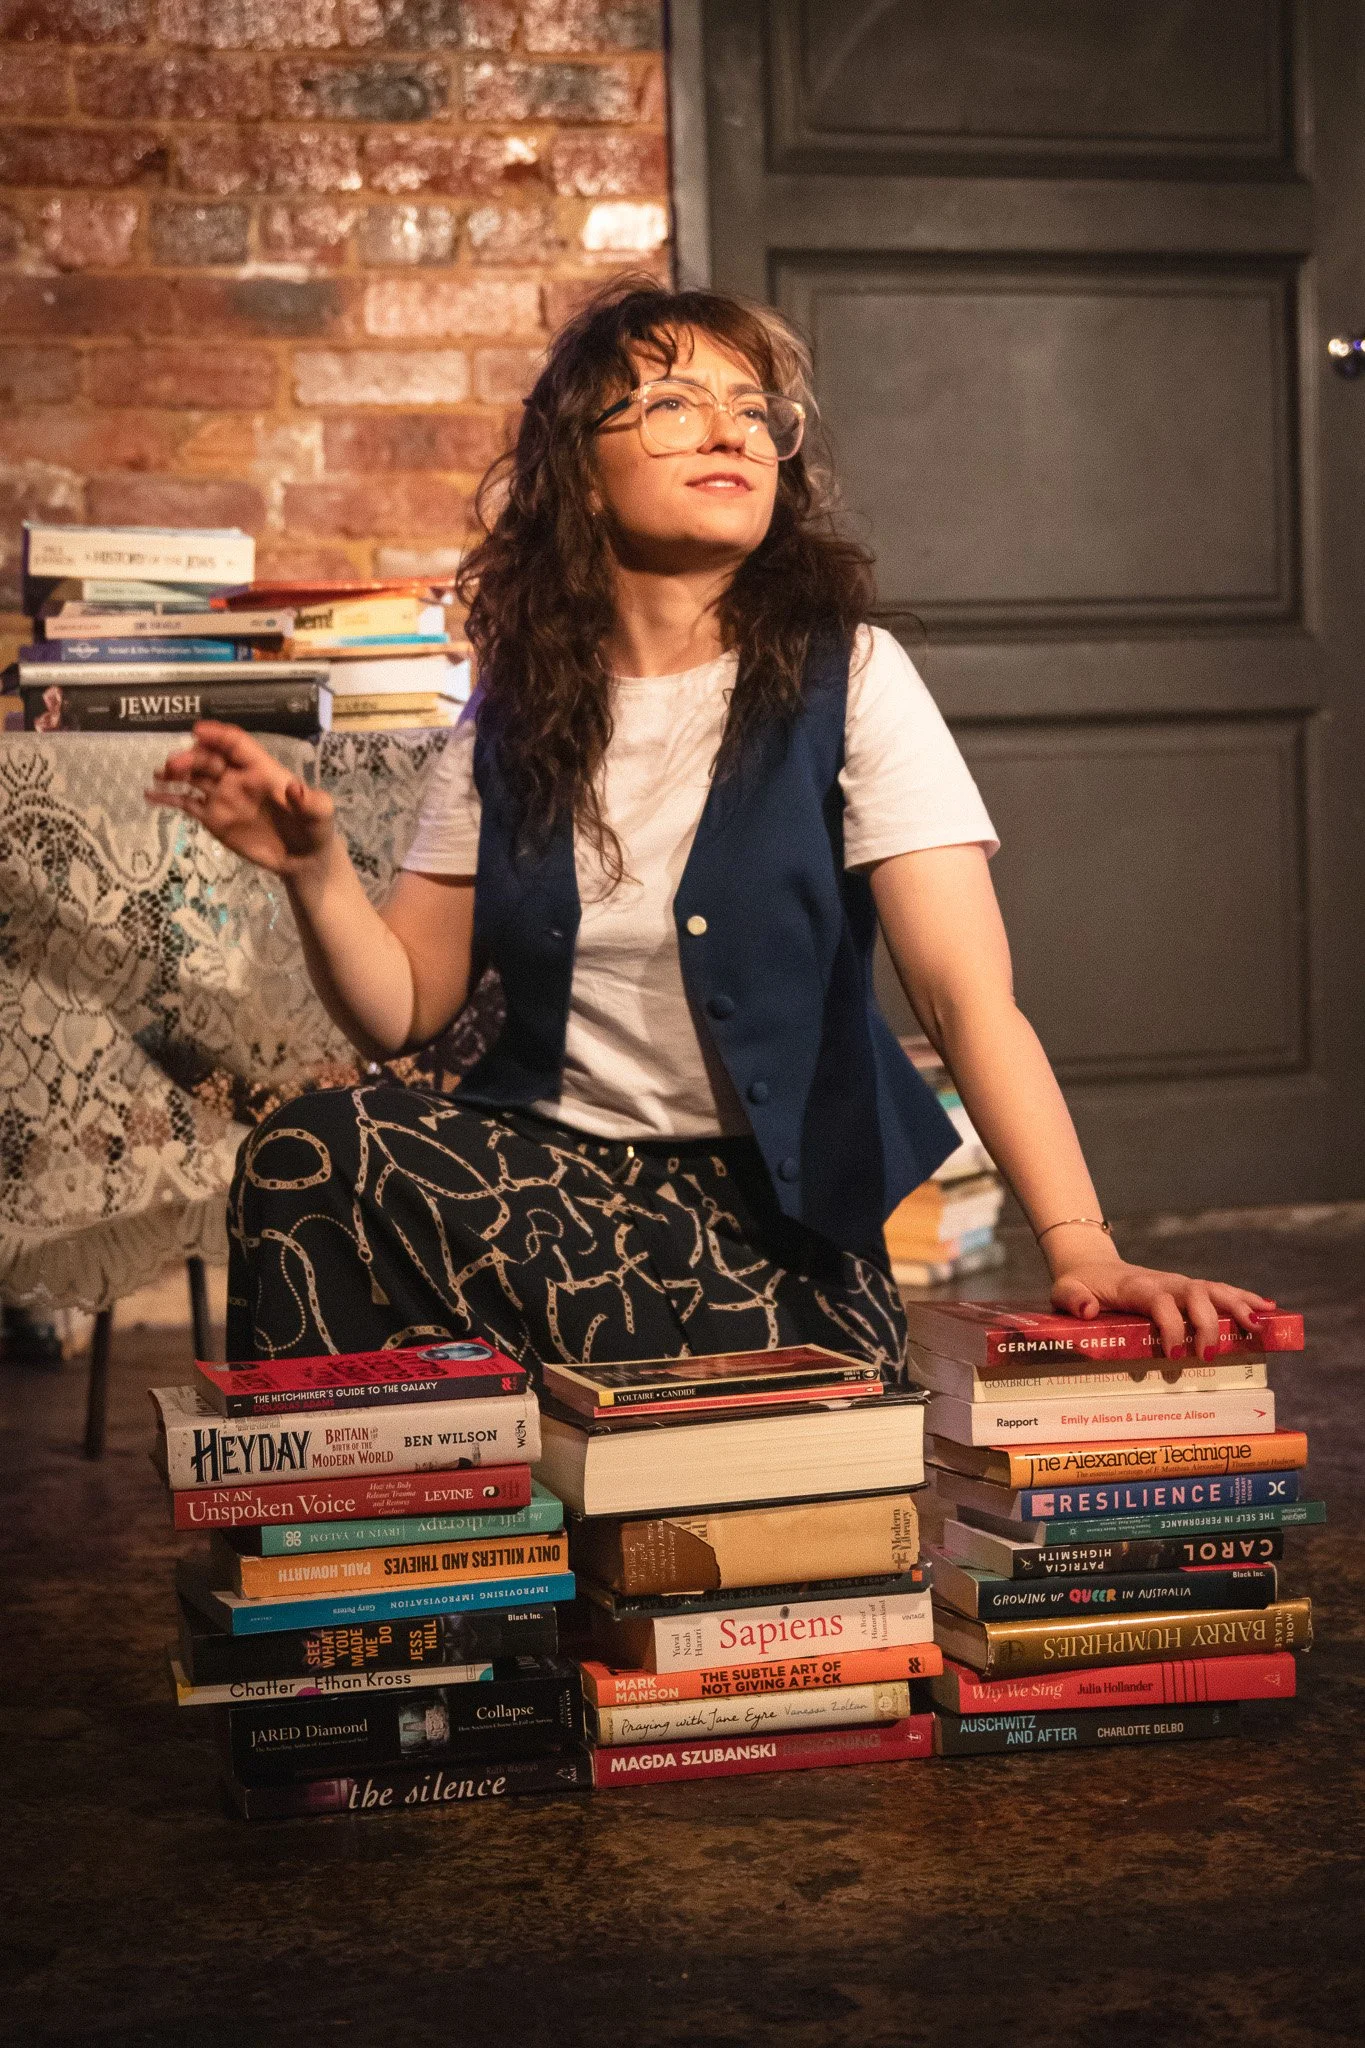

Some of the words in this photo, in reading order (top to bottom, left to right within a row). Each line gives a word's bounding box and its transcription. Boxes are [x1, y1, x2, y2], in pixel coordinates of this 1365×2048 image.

[119, 695, 200, 718] JEWISH
[997, 1339, 1074, 1353] GERMAINE
[1080, 1336, 1126, 1349] GREER
[985, 1377, 1041, 1389] GOMBRICH
[1056, 1375, 1091, 1384] LITTLE
[1180, 1368, 1216, 1379] WORLD
[254, 1395, 269, 1403] THE
[272, 1390, 334, 1402] HITCHHIKER'S
[336, 1387, 365, 1397] GUIDE
[368, 1387, 380, 1395] TO
[383, 1385, 398, 1393] THE
[401, 1382, 437, 1392] GALAXY
[617, 1392, 655, 1402] VOLTAIRE
[661, 1388, 696, 1398] CANDIDE
[253, 1402, 300, 1413] DOUGLAS
[303, 1400, 334, 1409] ADAMS
[997, 1418, 1038, 1429] Rapport
[1061, 1415, 1089, 1425] Emily
[1092, 1413, 1123, 1423] Alison
[1126, 1413, 1133, 1422] &
[1135, 1411, 1182, 1421] Laurence
[1184, 1410, 1216, 1420] Alison
[325, 1428, 368, 1445] BRITAIN
[404, 1435, 432, 1447] BEN
[438, 1430, 497, 1445] WILSON
[191, 1428, 312, 1484] HEYDAY
[312, 1453, 355, 1468] MODERN
[358, 1450, 393, 1464] WORLD
[1024, 1453, 1061, 1488] The
[1063, 1447, 1157, 1469] Alexander
[1160, 1443, 1252, 1473] Technique
[214, 1492, 230, 1502] IN
[234, 1491, 252, 1501] AN
[425, 1489, 474, 1502] LEVINE
[1060, 1484, 1221, 1513] RESILIENCE
[187, 1498, 294, 1525] Unspoken
[298, 1494, 356, 1515] Voice
[529, 1511, 543, 1521] the
[1236, 1513, 1256, 1522] SELF
[1260, 1512, 1275, 1521] THE
[418, 1516, 482, 1532] therapy
[501, 1510, 525, 1528] gift
[1160, 1516, 1222, 1529] PERFORMANCE
[1225, 1515, 1234, 1523] IN
[310, 1532, 349, 1543] YALOM
[352, 1530, 364, 1538] D.
[369, 1527, 401, 1538] IRVIN
[891, 1509, 901, 1550] Modern
[901, 1510, 912, 1551] Library
[472, 1548, 524, 1568] KILLERS
[527, 1545, 560, 1563] ONLY
[1038, 1549, 1111, 1562] HIGHSMITH
[1183, 1539, 1273, 1561] CAROL
[341, 1562, 371, 1576] PAUL
[384, 1553, 438, 1575] THIEVES
[442, 1552, 469, 1570] AND
[1046, 1561, 1104, 1573] PATRICIA
[278, 1565, 337, 1583] HOWARTH
[390, 1593, 474, 1608] IMPROVISATION
[480, 1586, 549, 1600] IMPROVISING
[993, 1593, 1046, 1606] GROWING
[1050, 1592, 1064, 1602] UP
[1069, 1588, 1117, 1604] QUEER
[1122, 1590, 1134, 1599] IN
[1138, 1587, 1191, 1599] AUSTRALIA
[333, 1606, 355, 1614] Peters
[357, 1604, 375, 1612] Gary
[508, 1613, 528, 1621] Black
[869, 1604, 876, 1612] of
[902, 1612, 926, 1621] VINTAGE
[879, 1599, 888, 1642] Humankind
[1274, 1608, 1283, 1648] PLEASE
[1285, 1613, 1295, 1644] MORE
[379, 1625, 392, 1644] DO
[424, 1620, 437, 1649] HILL
[720, 1614, 843, 1655] Sapiens
[1190, 1619, 1266, 1647] BARRY
[322, 1629, 335, 1669] WHAT
[336, 1630, 349, 1657] YOU
[350, 1628, 364, 1667] MADE
[366, 1637, 378, 1657] ME
[410, 1630, 423, 1660] JESS
[671, 1633, 681, 1658] Yuval
[683, 1632, 692, 1657] Noah
[694, 1628, 703, 1657] Harari
[1043, 1627, 1181, 1660] HUMPHRIES
[307, 1640, 320, 1665] SEE
[700, 1671, 729, 1683] THE
[732, 1666, 786, 1680] SUBTLE
[790, 1663, 818, 1675] ART
[822, 1661, 841, 1673] OF
[230, 1681, 295, 1698] Chatter
[314, 1674, 361, 1691] Ethan
[366, 1672, 411, 1687] Kross
[614, 1677, 658, 1691] MARK
[701, 1683, 730, 1696] NOT
[735, 1678, 785, 1693] GIVING
[789, 1676, 799, 1688] A
[1077, 1683, 1101, 1695] Julia
[1103, 1681, 1154, 1695] Hollander
[615, 1687, 679, 1704] MANSON
[972, 1684, 1003, 1703] Why
[1006, 1683, 1029, 1698] We
[1031, 1683, 1064, 1700] Sing
[476, 1704, 534, 1721] Collapse
[784, 1703, 826, 1716] Vanessa
[831, 1698, 868, 1711] Zoltan
[621, 1718, 670, 1739] Praying
[676, 1710, 707, 1727] with
[707, 1708, 739, 1731] Jane
[745, 1707, 778, 1729] Eyre
[960, 1715, 1037, 1733] AUSCHWITZ
[1097, 1724, 1151, 1738] CHARLOTTE
[1154, 1722, 1184, 1735] DELBO
[251, 1727, 301, 1747] JARED
[306, 1719, 368, 1738] Diamond
[1006, 1730, 1033, 1745] AND
[1037, 1727, 1077, 1742] AFTER
[610, 1752, 677, 1773] MAGDA
[681, 1743, 777, 1766] SZUBANSKI
[348, 1779, 393, 1810] the
[405, 1772, 507, 1804] silence
